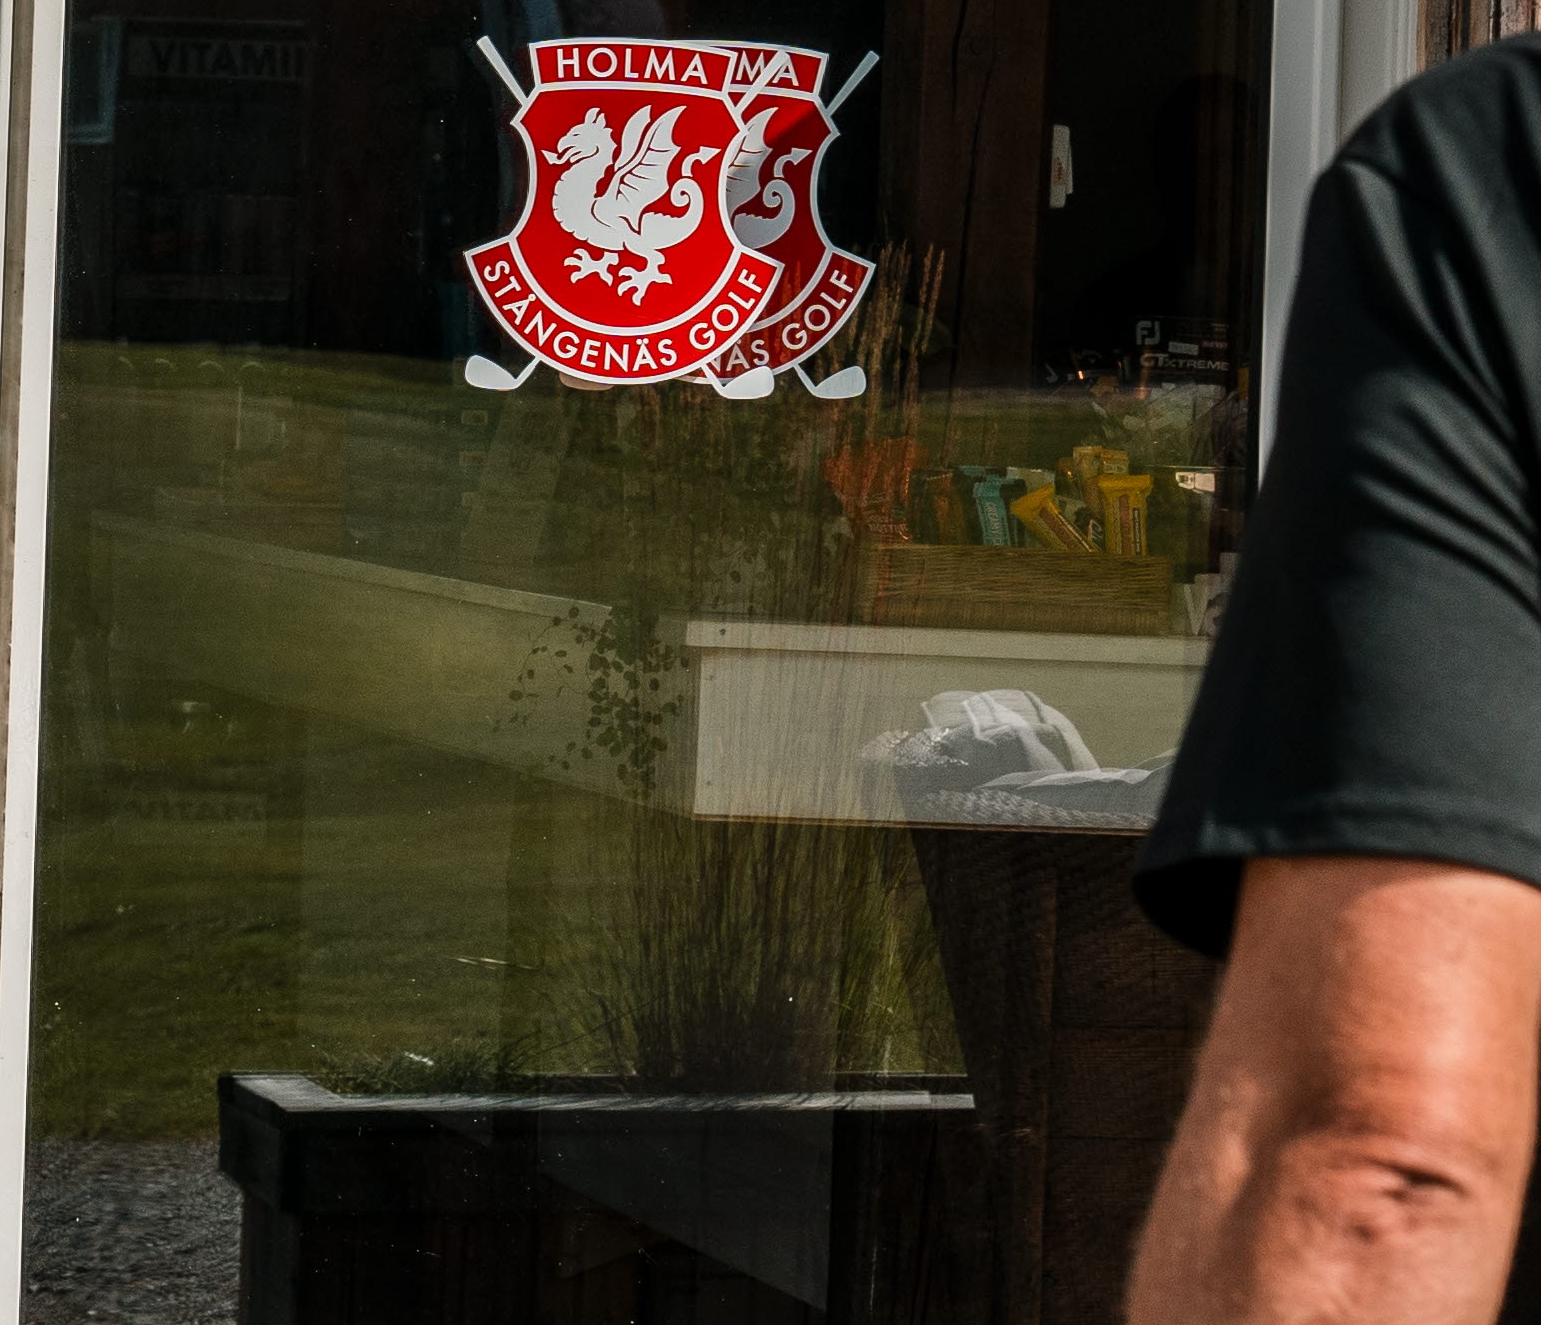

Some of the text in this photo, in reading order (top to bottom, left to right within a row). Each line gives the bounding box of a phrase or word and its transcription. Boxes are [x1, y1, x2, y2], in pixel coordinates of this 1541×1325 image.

[557, 47, 709, 85] HOLMA
[483, 259, 764, 372] STÅNGENÄS GOLF
[782, 269, 855, 351] GOLF
